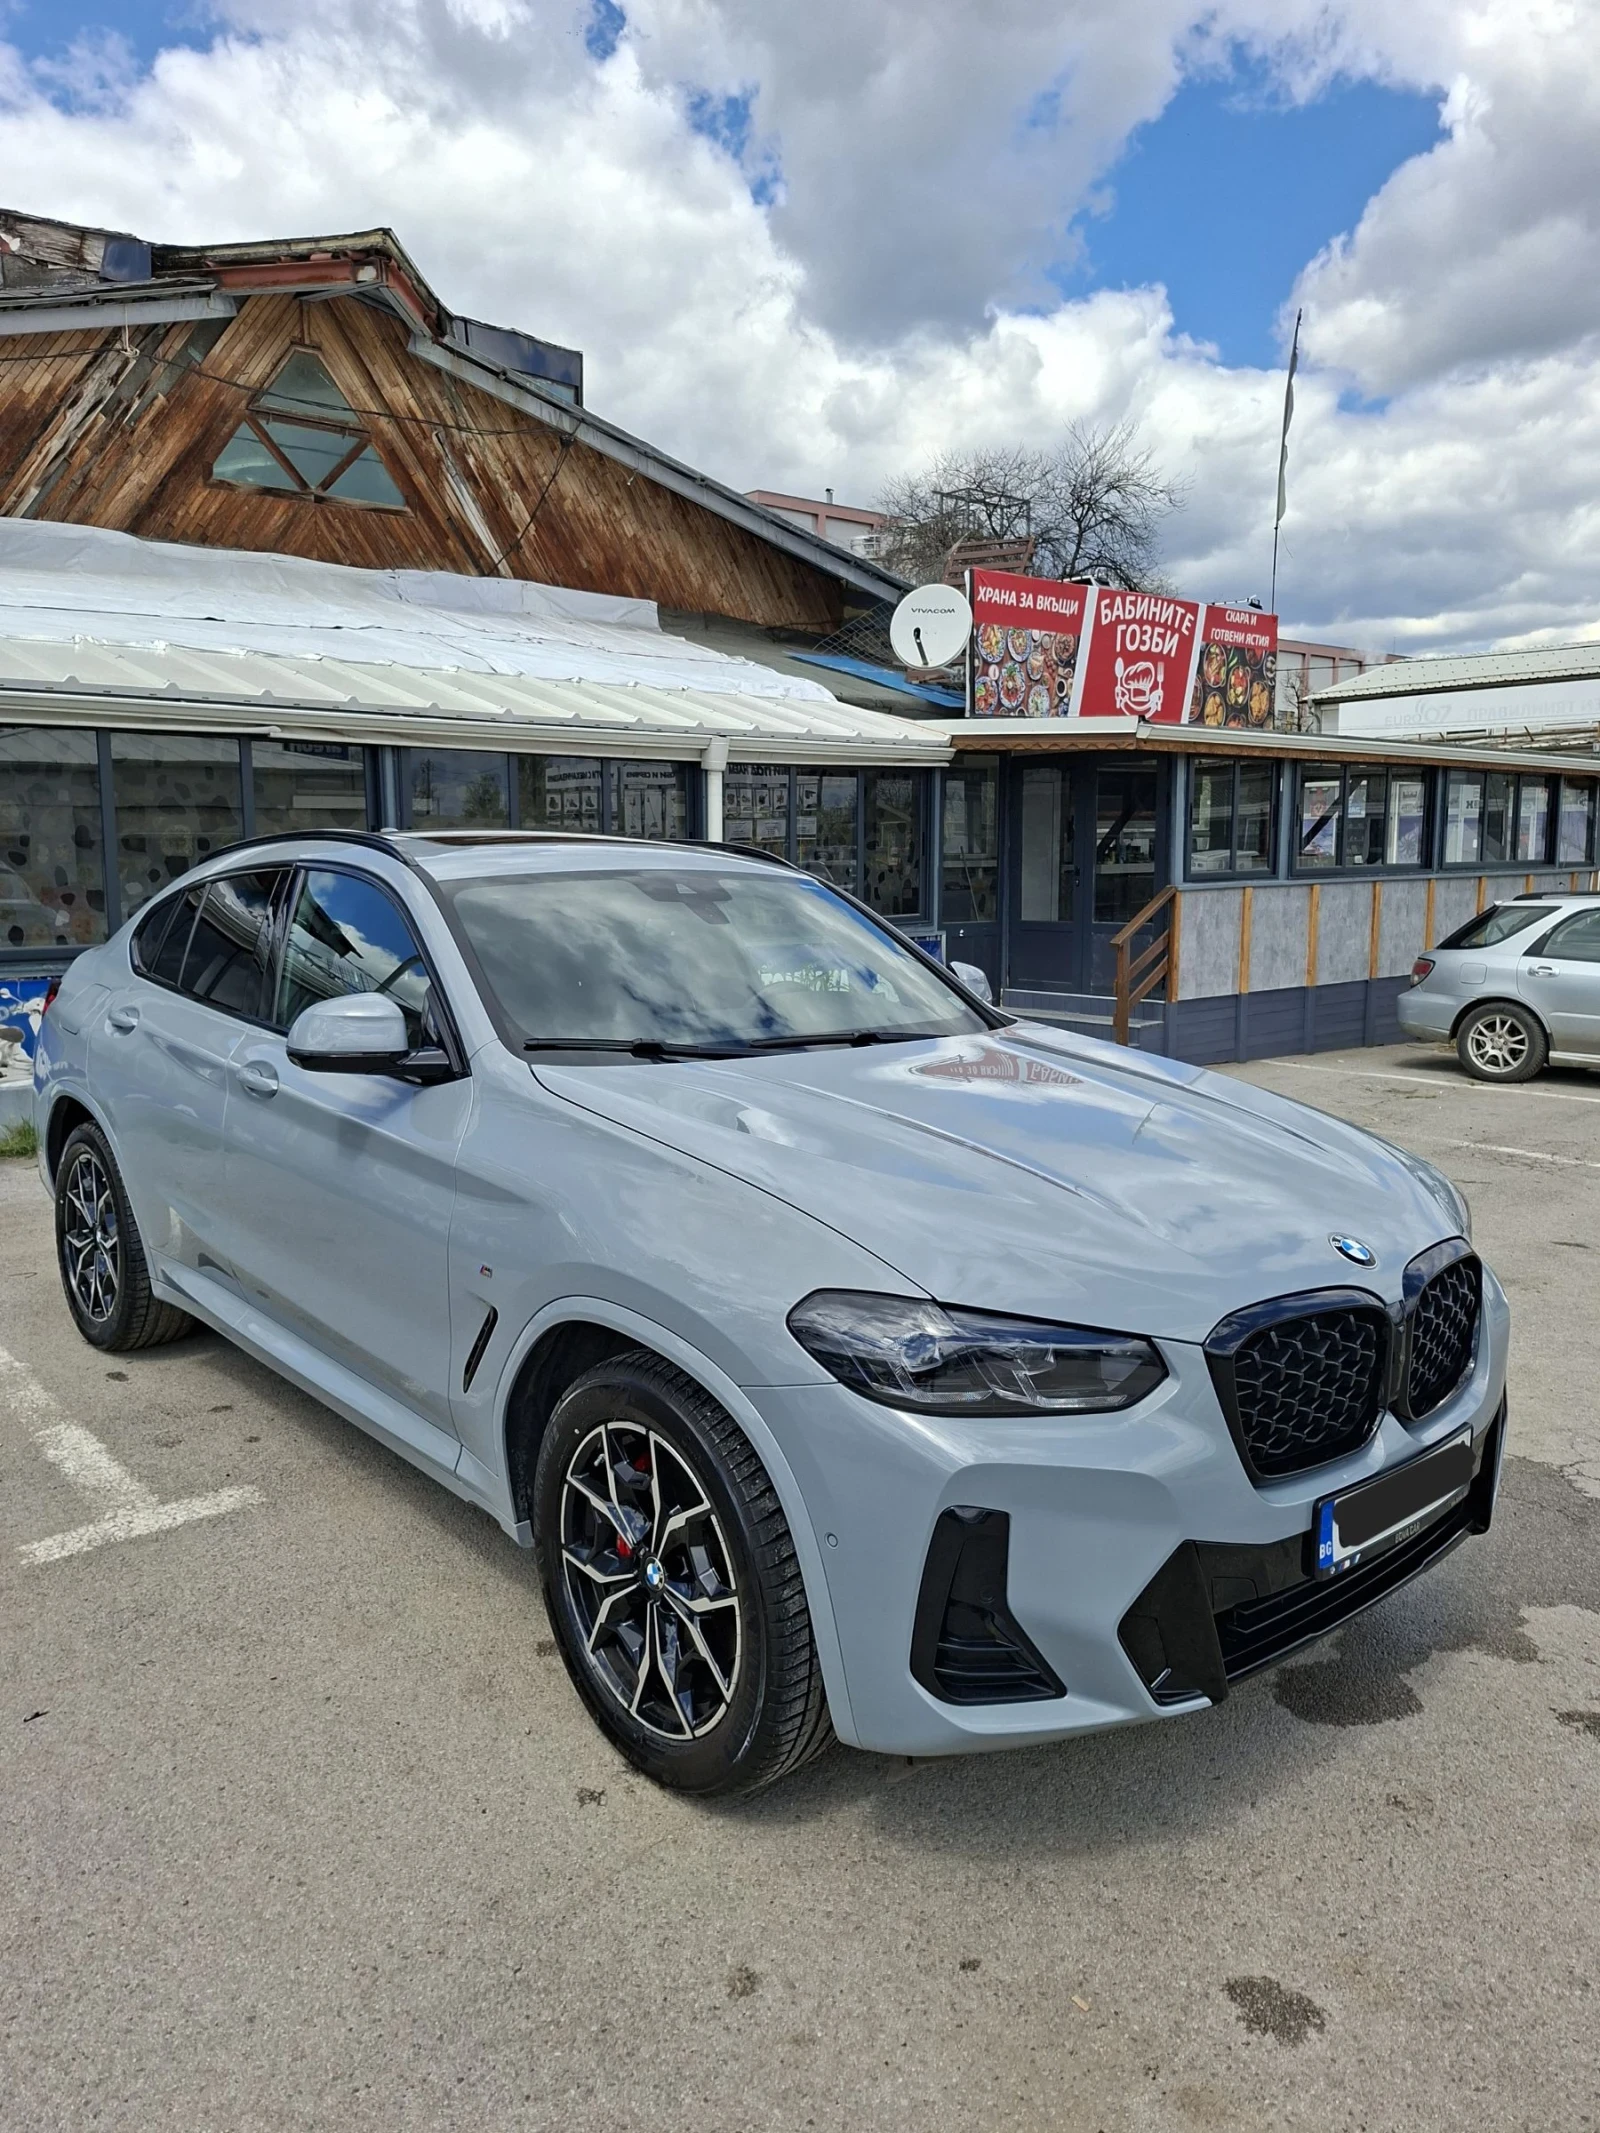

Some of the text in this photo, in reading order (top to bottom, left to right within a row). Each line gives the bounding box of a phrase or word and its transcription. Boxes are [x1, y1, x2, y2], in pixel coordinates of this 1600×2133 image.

[976, 586, 1079, 617] ХРАНА ЗА ВКЪЩИ
[1100, 595, 1195, 636] БАБИНИТЕ
[1225, 610, 1258, 627] СКАРА И
[1116, 624, 1180, 658] ГОЗБИ
[1210, 628, 1270, 648] ГОТВЕНИ ЯСТИЯ
[1319, 1541, 1332, 1560] BG
